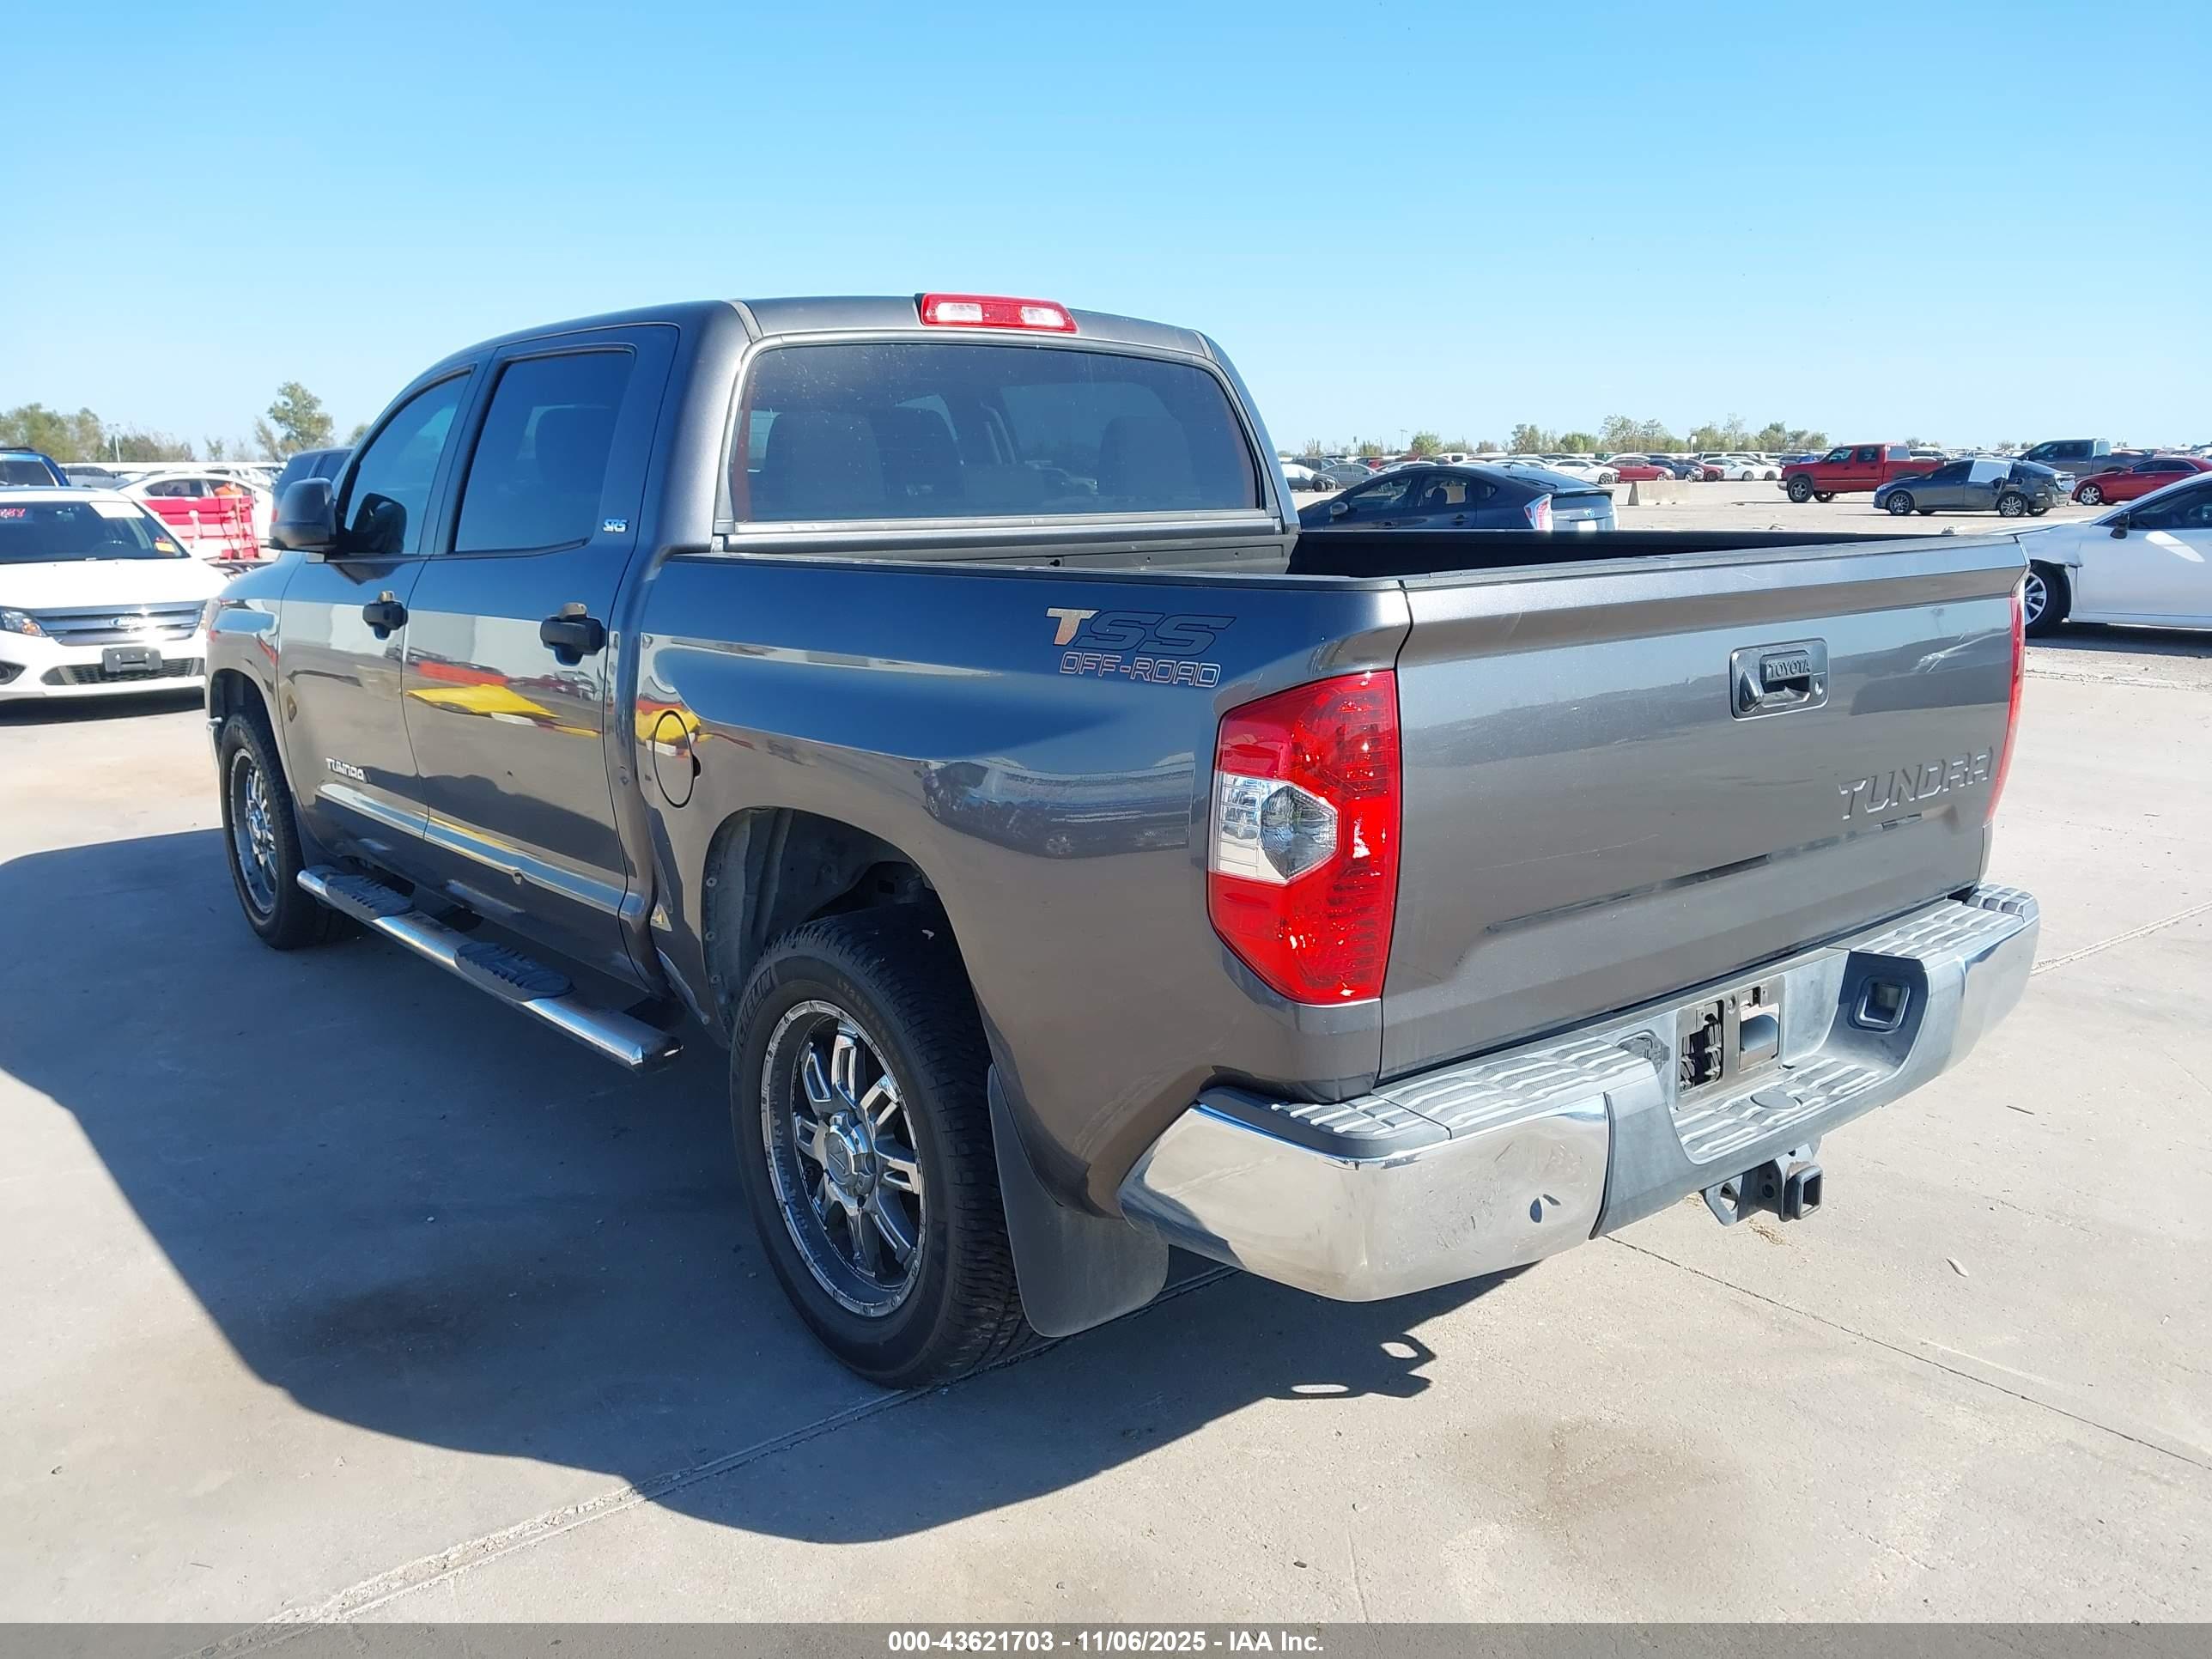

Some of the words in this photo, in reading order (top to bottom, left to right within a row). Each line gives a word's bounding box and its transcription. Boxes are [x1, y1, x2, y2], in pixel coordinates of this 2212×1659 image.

[603, 519, 627, 532] SR5
[1046, 607, 1237, 656] TSS
[1060, 651, 1221, 688] OFF-ROAD
[1768, 658, 1811, 678] TOYOTA
[1838, 747, 1993, 821] TUNDRA
